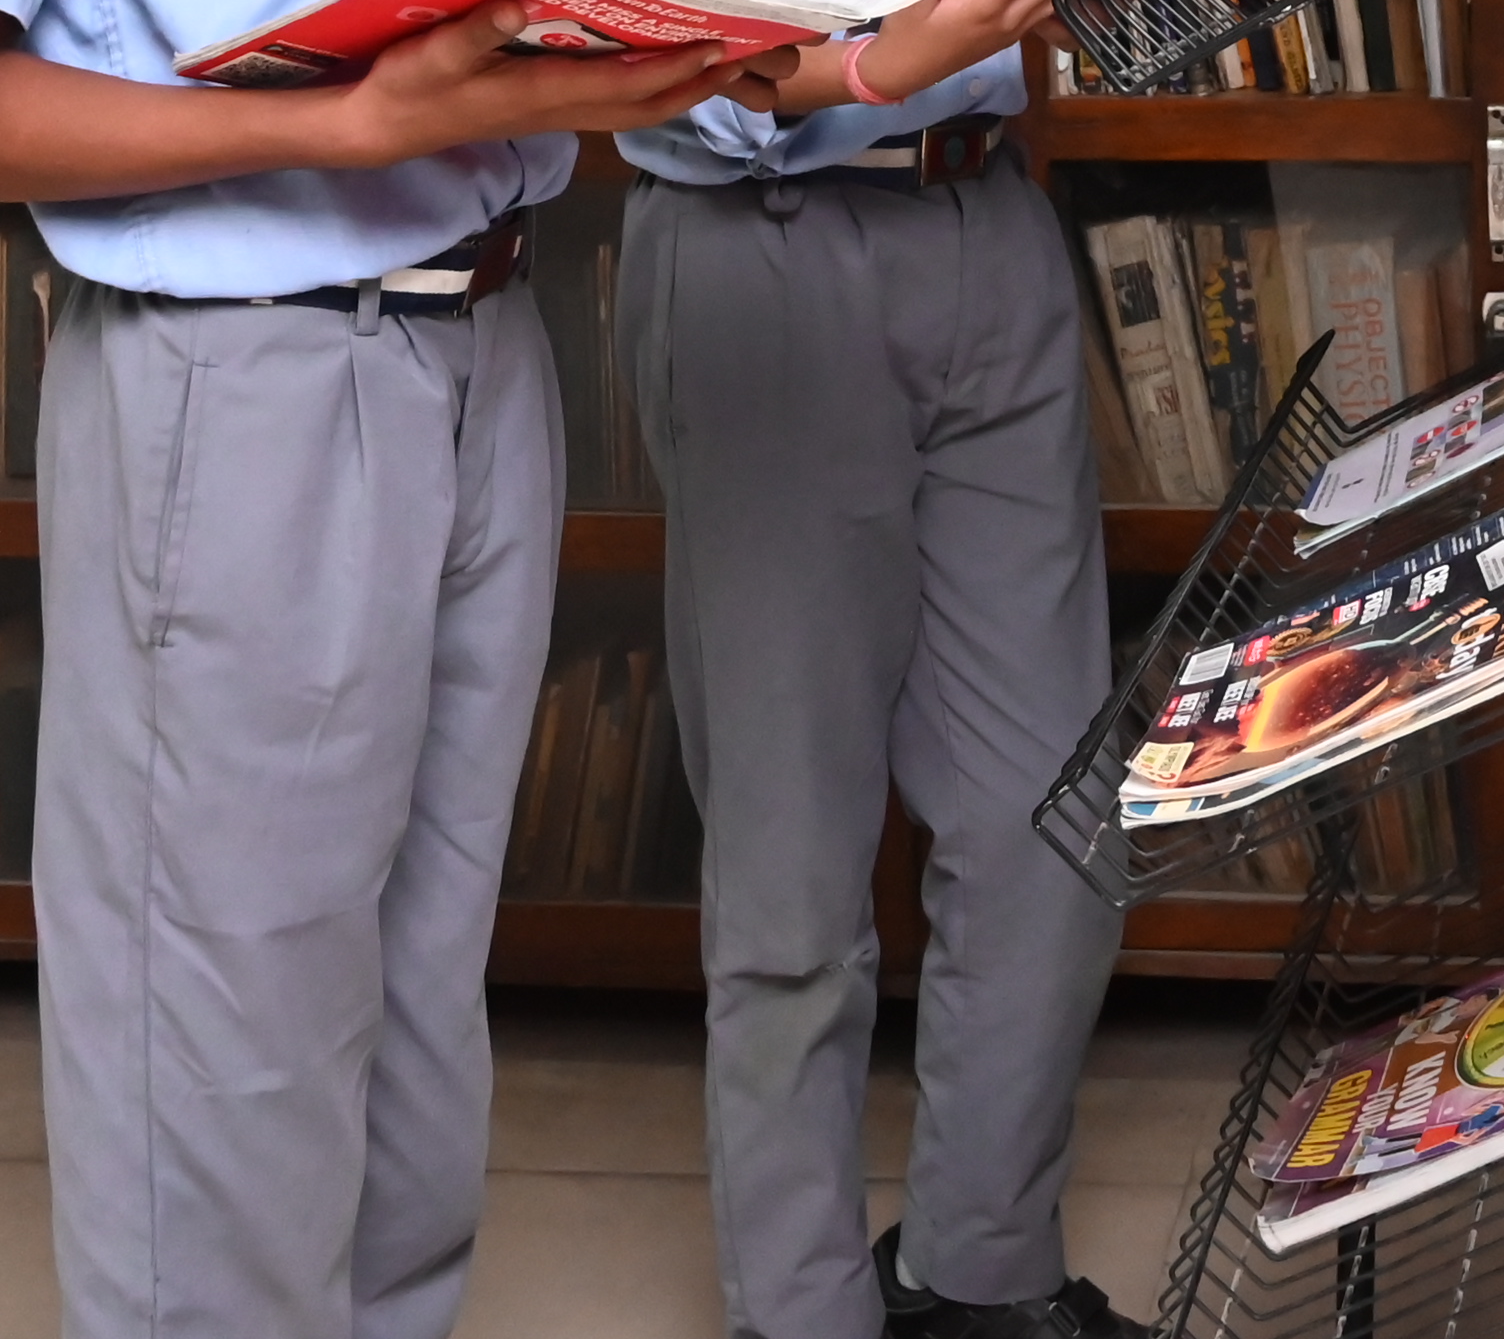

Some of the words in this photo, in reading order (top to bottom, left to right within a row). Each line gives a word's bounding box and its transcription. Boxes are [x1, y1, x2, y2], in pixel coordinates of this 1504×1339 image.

[1422, 563, 1451, 599] CBSE
[1358, 589, 1385, 625] FOCUS
[1350, 1083, 1400, 1134] YOUR
[1386, 1051, 1448, 1131] KNOW
[1285, 1068, 1375, 1169] GRAMMAR
